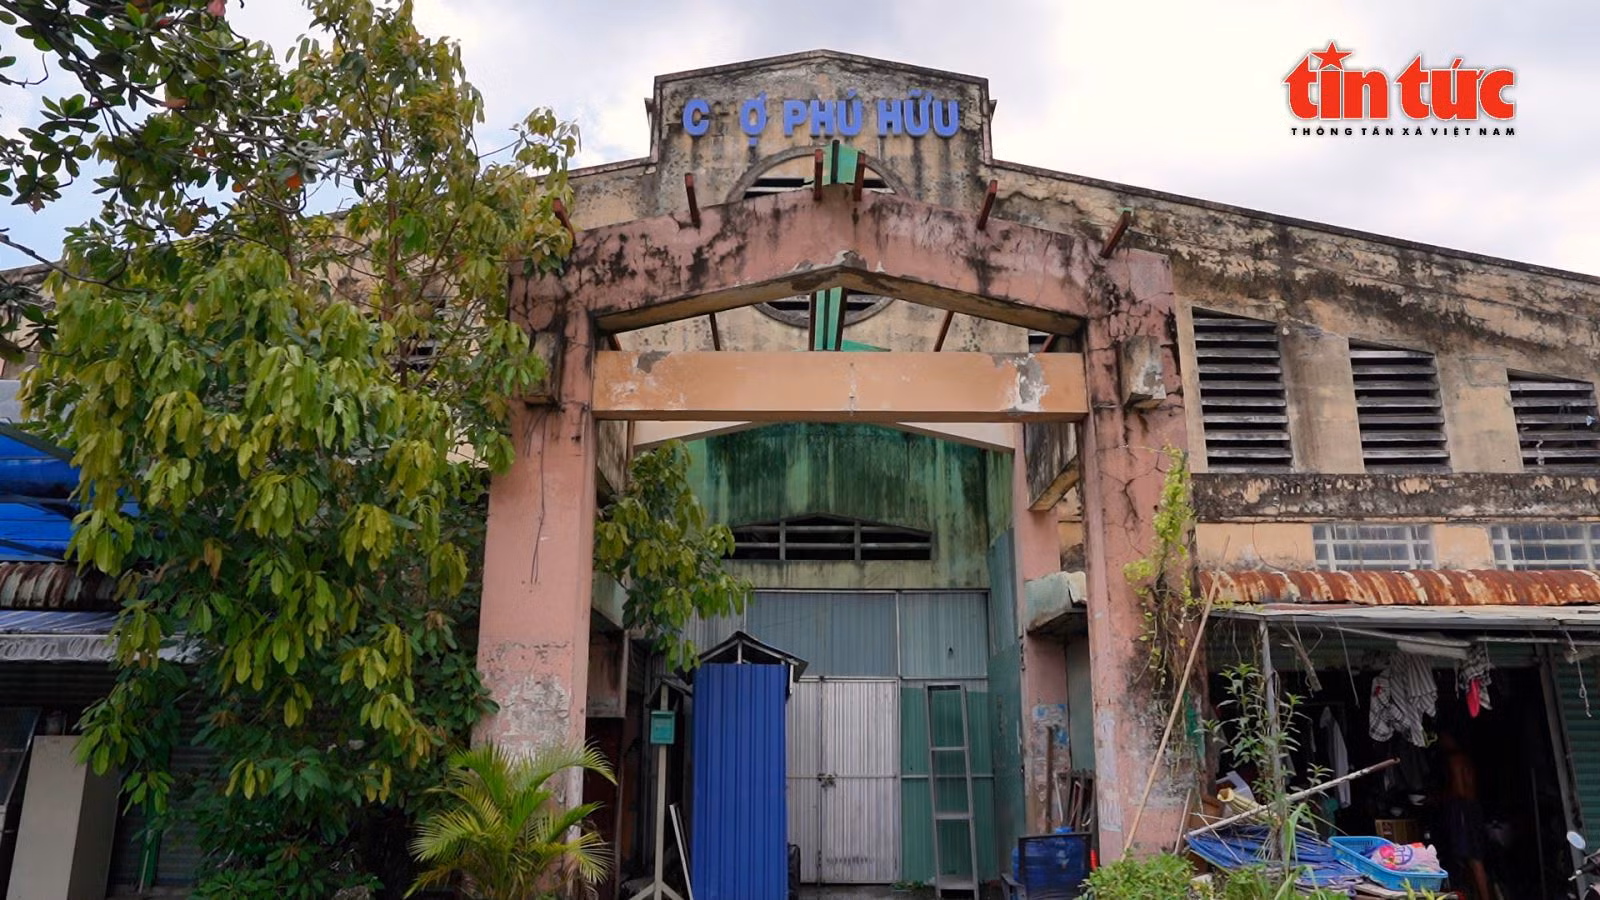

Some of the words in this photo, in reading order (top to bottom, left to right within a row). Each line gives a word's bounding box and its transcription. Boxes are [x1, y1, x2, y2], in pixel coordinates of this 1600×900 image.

[683, 92, 767, 147] CỢ
[783, 89, 863, 137] PHÚ
[877, 88, 961, 138] HỮU
